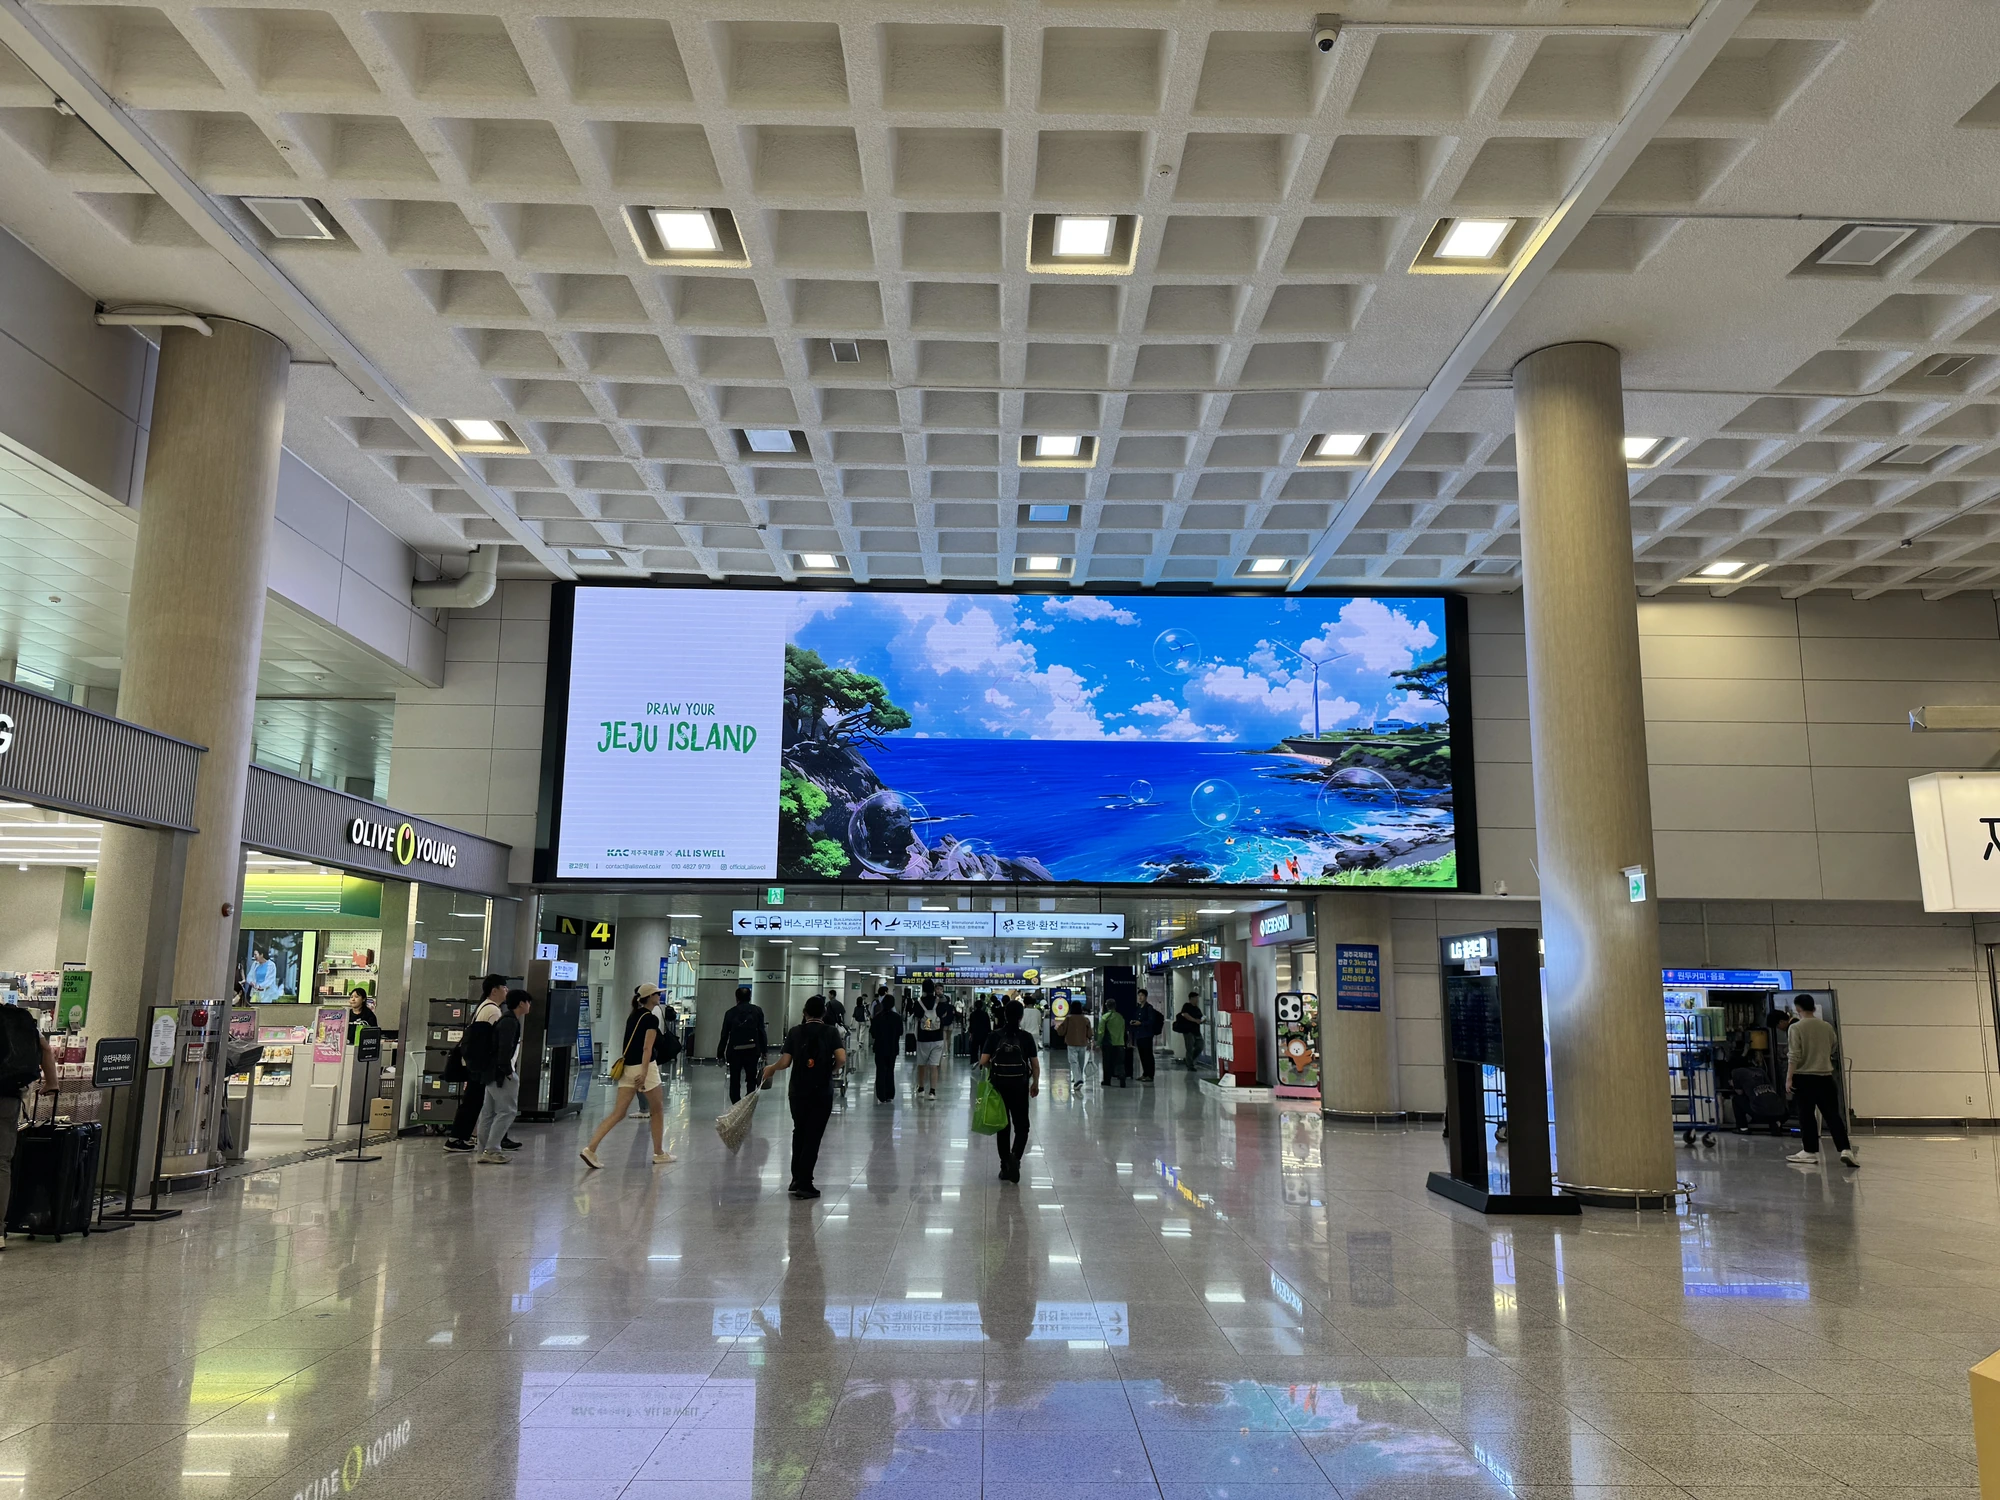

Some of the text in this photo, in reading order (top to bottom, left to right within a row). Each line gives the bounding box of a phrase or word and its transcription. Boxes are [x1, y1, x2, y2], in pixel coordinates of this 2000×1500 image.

[646, 702, 716, 716] DRAW YOUR
[597, 721, 757, 754] JEJU ISLAND
[352, 818, 457, 868] OLIVE YOUNG
[607, 849, 630, 857] KAC
[630, 849, 665, 857] 제주국제공항
[675, 849, 691, 858] ALL
[693, 849, 702, 858] IS
[702, 849, 726, 858] WELL
[590, 922, 611, 943] 4
[902, 919, 949, 930] 국제선도착
